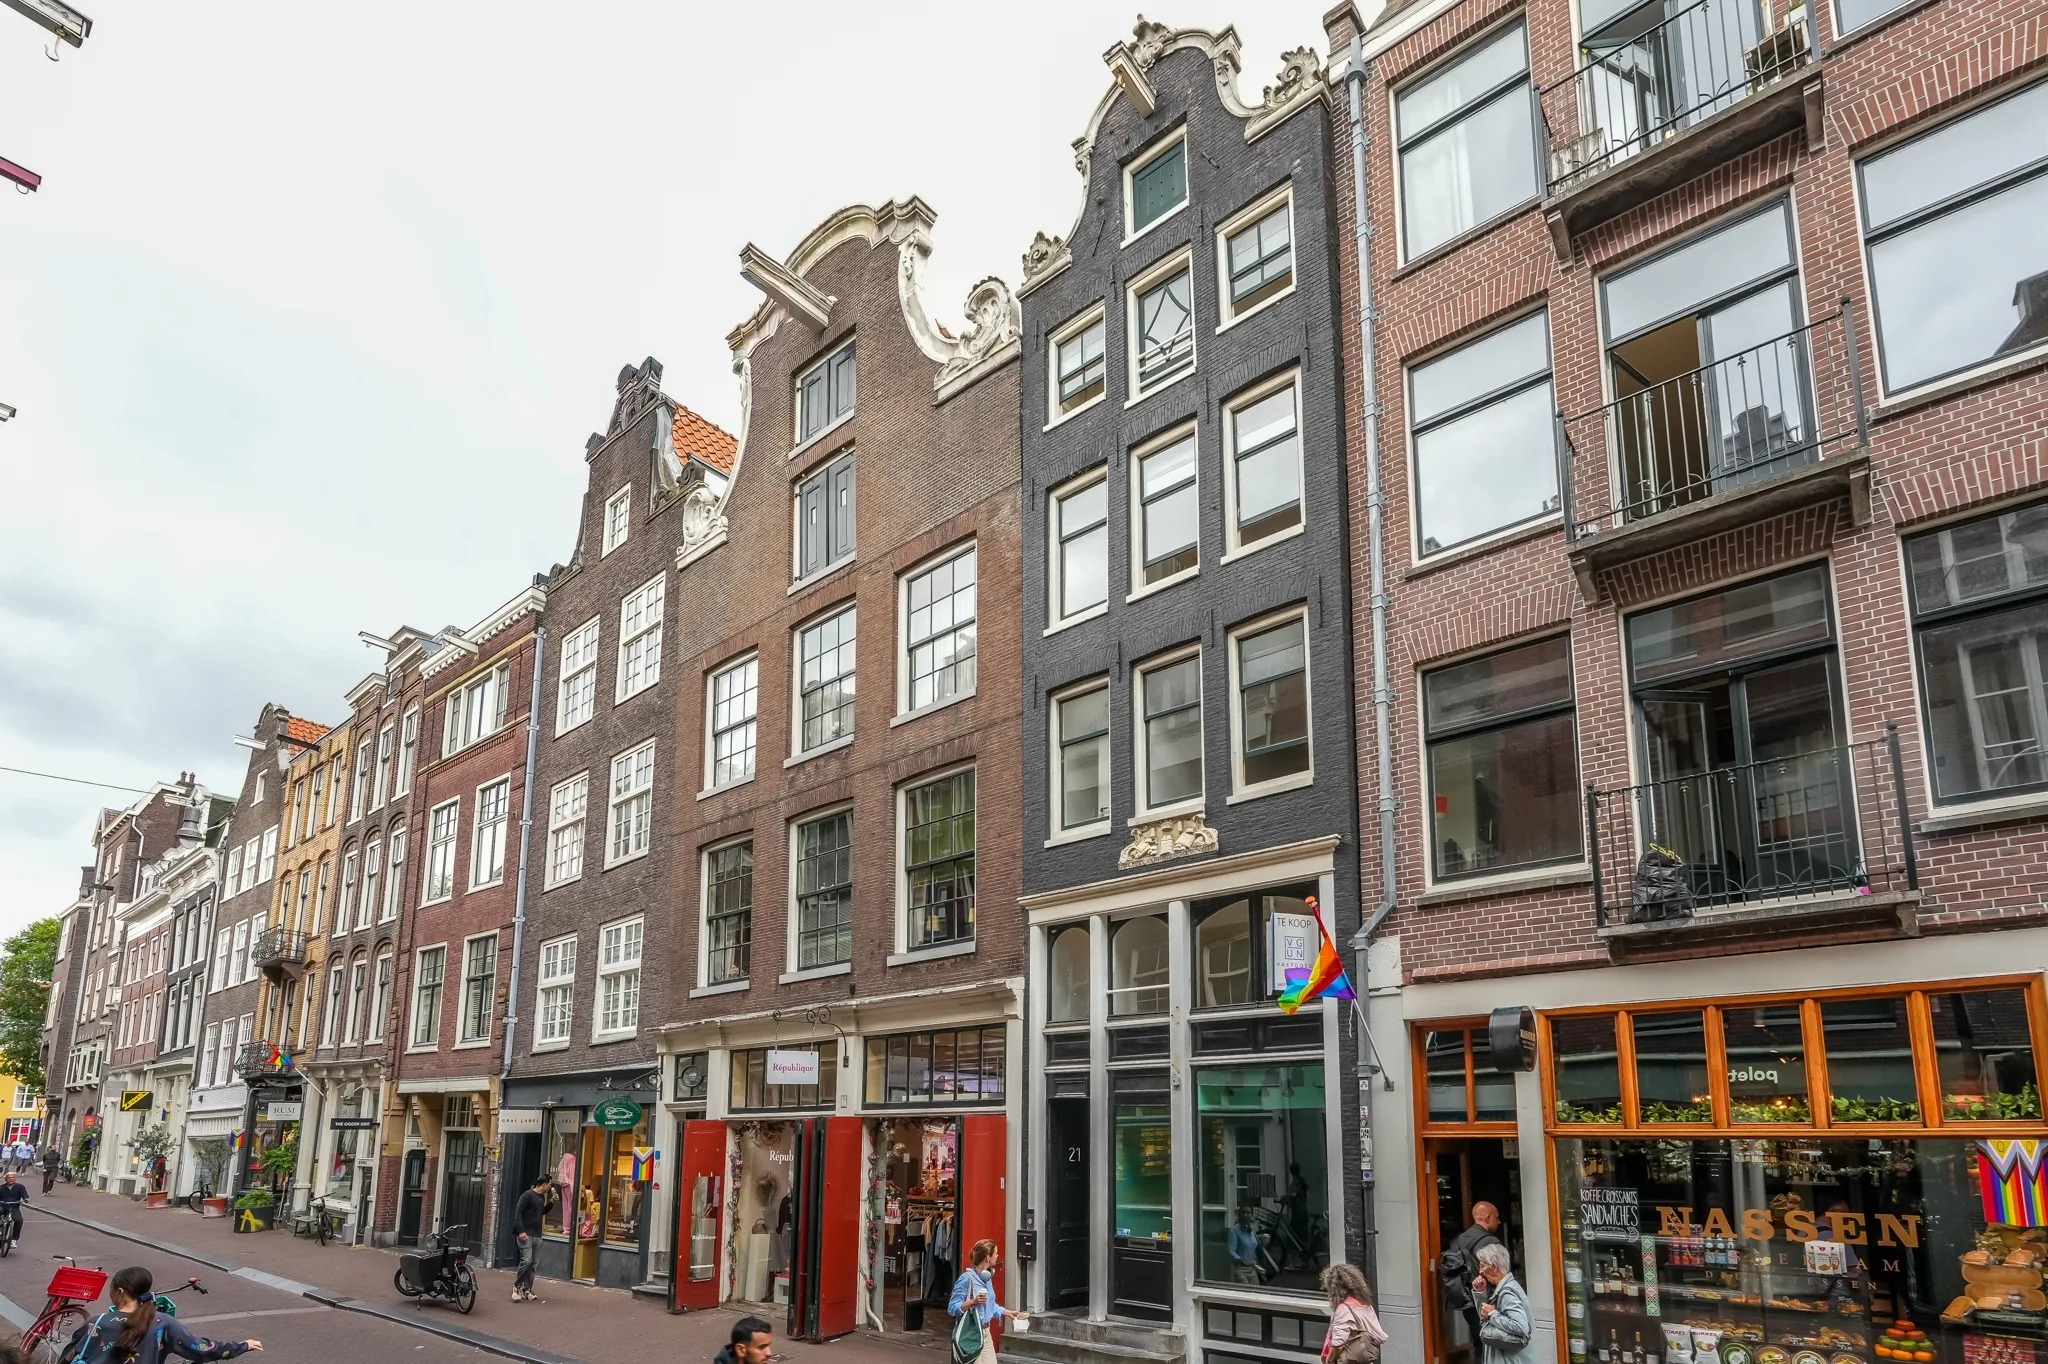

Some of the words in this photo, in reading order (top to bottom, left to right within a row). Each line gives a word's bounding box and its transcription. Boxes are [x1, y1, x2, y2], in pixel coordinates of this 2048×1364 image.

[1277, 917, 1286, 927] TE
[1288, 918, 1312, 929] KOOP
[773, 1063, 814, 1074] République
[1068, 1146, 1081, 1162] 21
[1580, 1203, 1639, 1227] SANDWICHES
[1656, 1206, 1921, 1248] NASSEN
